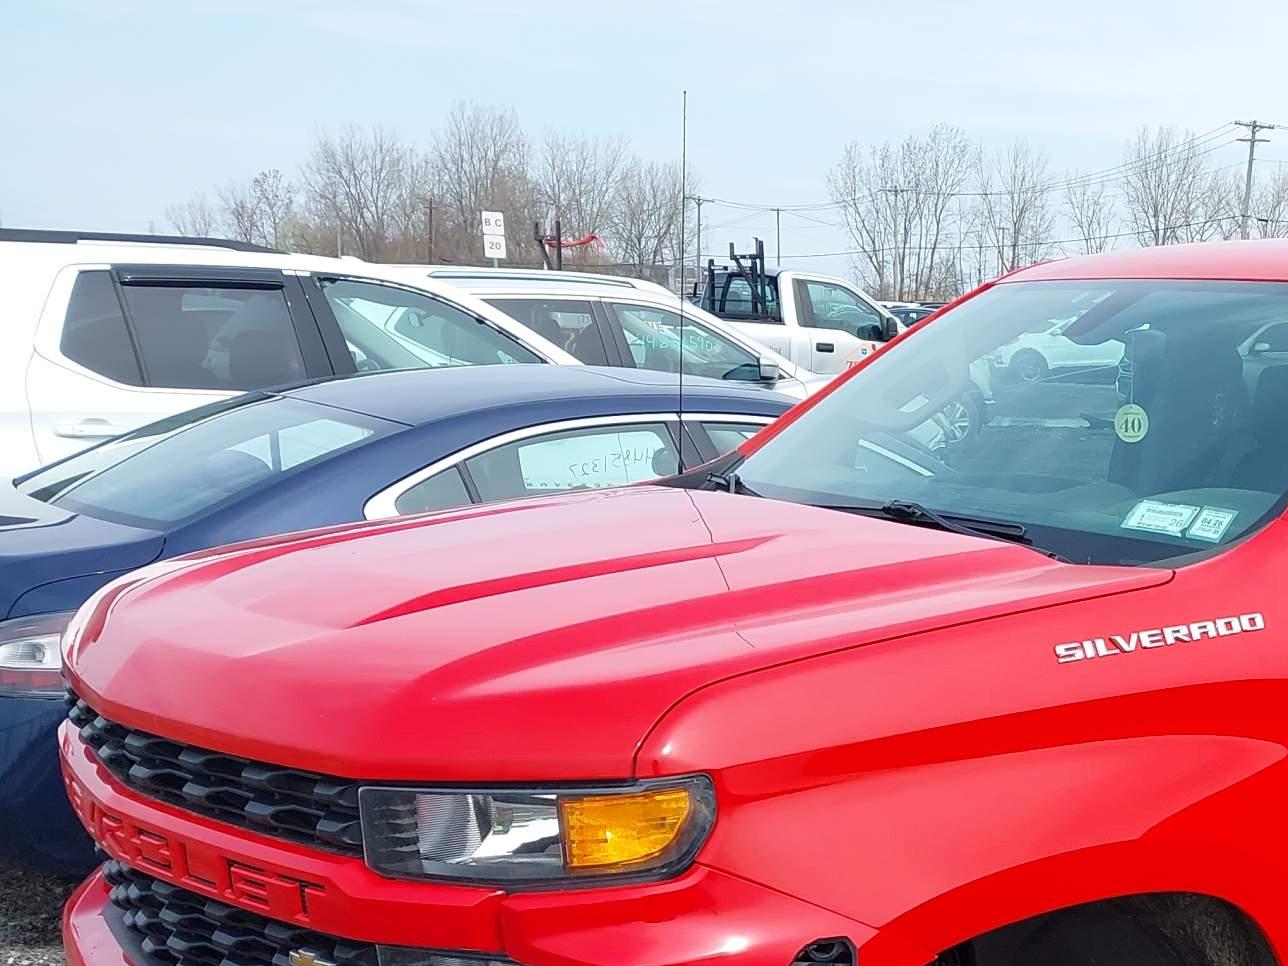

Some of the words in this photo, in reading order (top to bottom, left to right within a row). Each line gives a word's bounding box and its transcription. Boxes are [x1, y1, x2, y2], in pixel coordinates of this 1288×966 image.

[484, 217, 491, 227] B
[489, 241, 502, 250] 20
[1119, 416, 1142, 434] 40
[1055, 612, 1265, 664] SILVERADO
